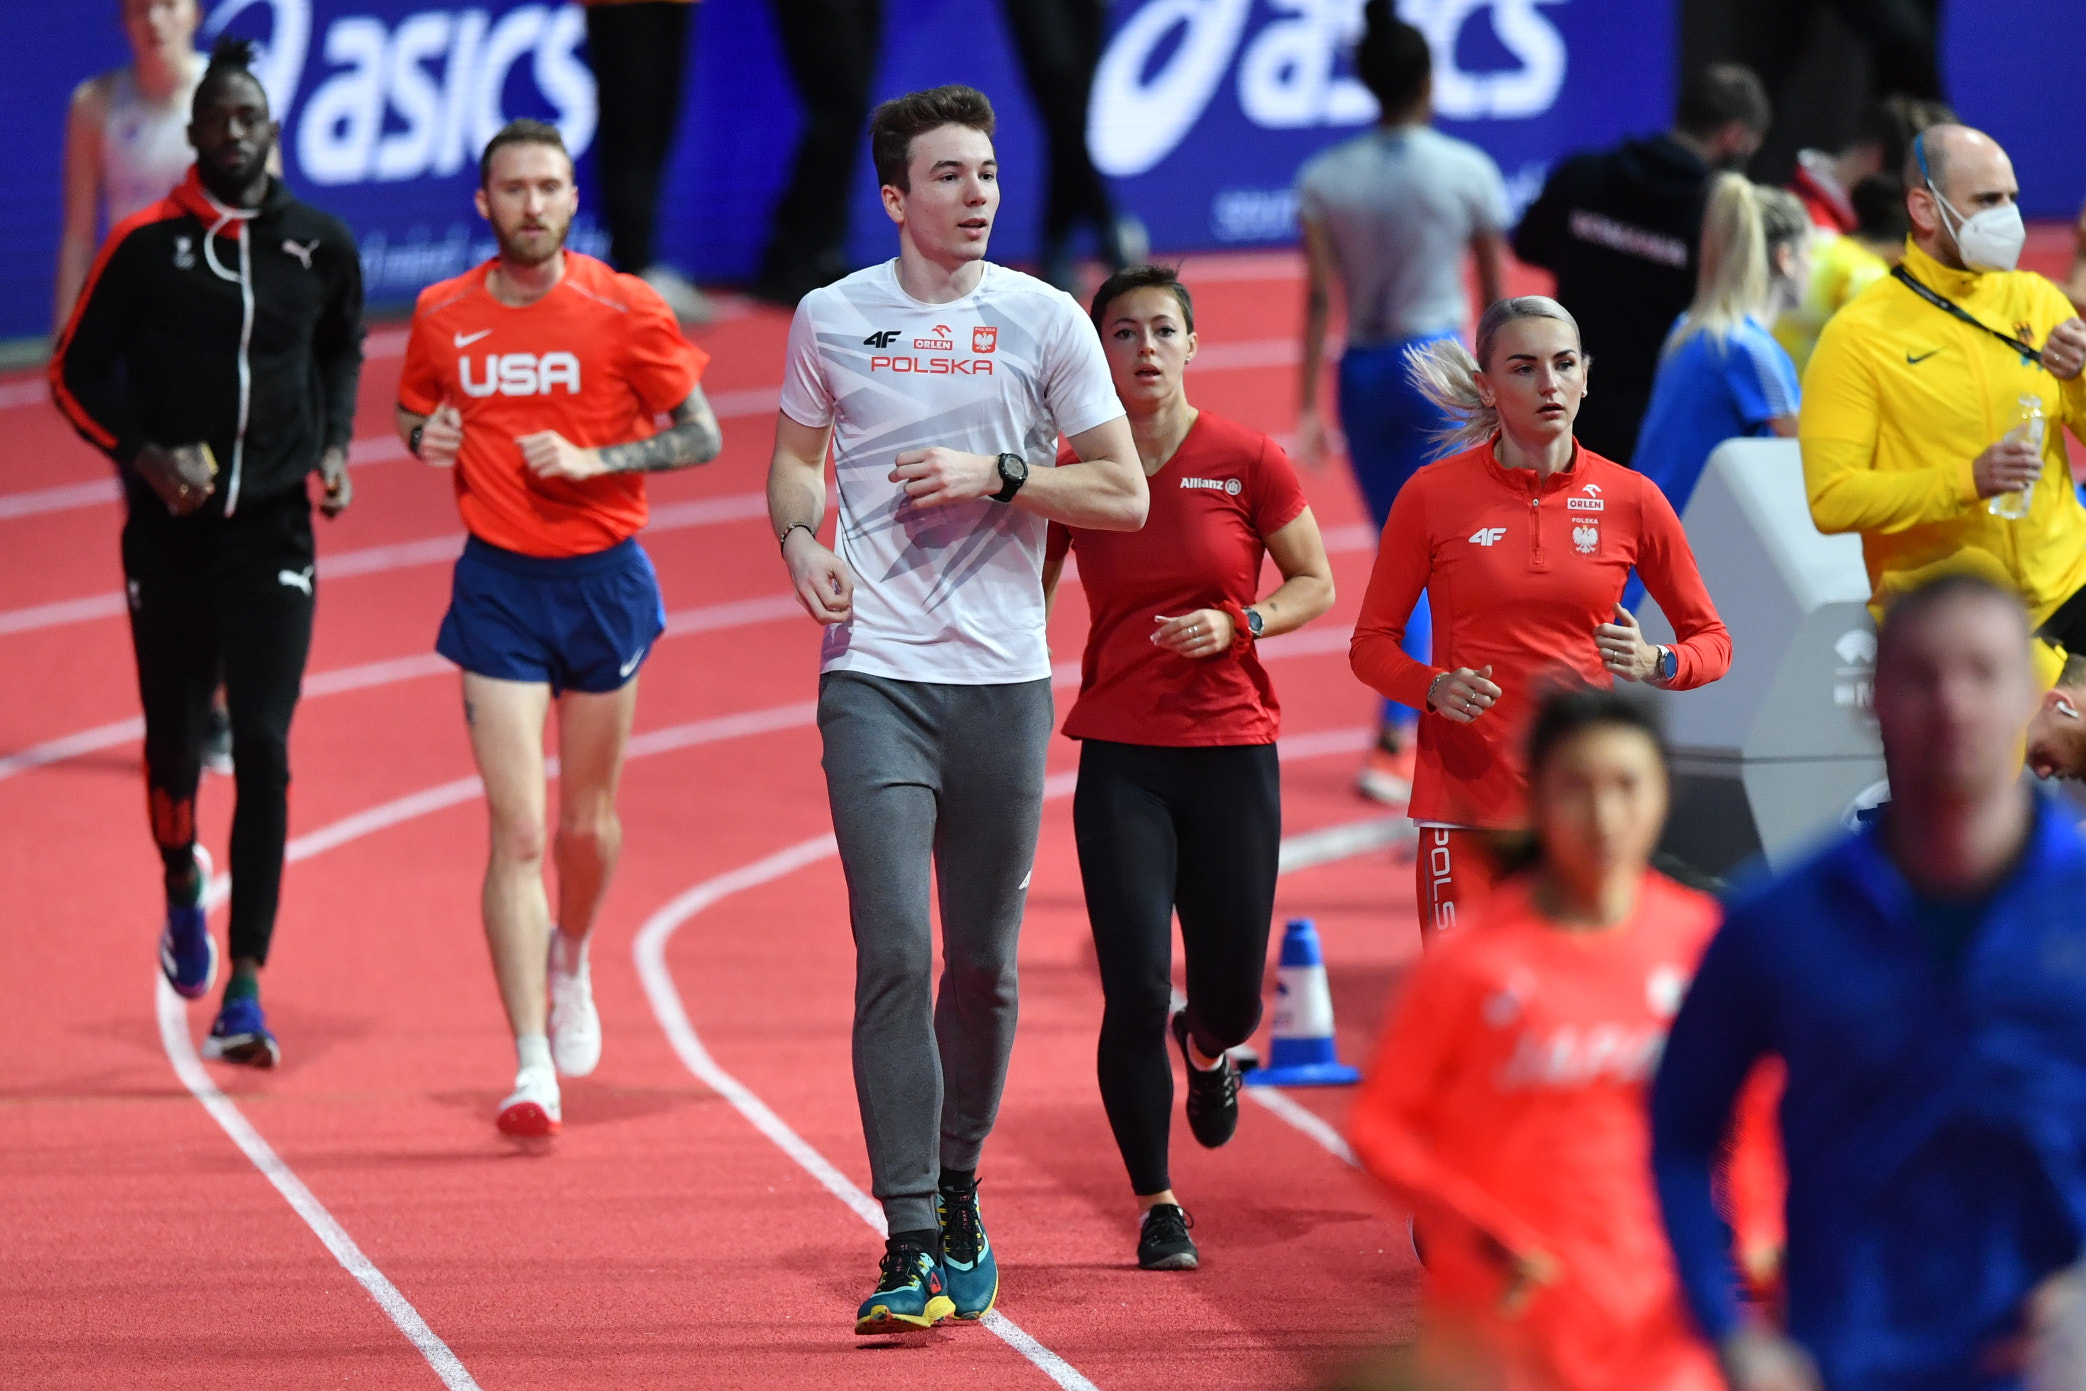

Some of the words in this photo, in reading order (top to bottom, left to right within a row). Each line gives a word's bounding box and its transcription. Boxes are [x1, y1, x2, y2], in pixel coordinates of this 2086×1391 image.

[1238, 0, 1569, 128] acs
[296, 3, 599, 185] asics
[863, 331, 902, 348] 4F
[915, 340, 951, 349] ORLEN
[458, 351, 581, 398] USA
[871, 356, 993, 375] POLSKA
[1180, 477, 1224, 490] Allianz
[1569, 499, 1601, 509] ORLEN
[1571, 517, 1599, 525] POLSKA
[1468, 528, 1507, 547] 4F
[1431, 828, 1457, 931] POLS
